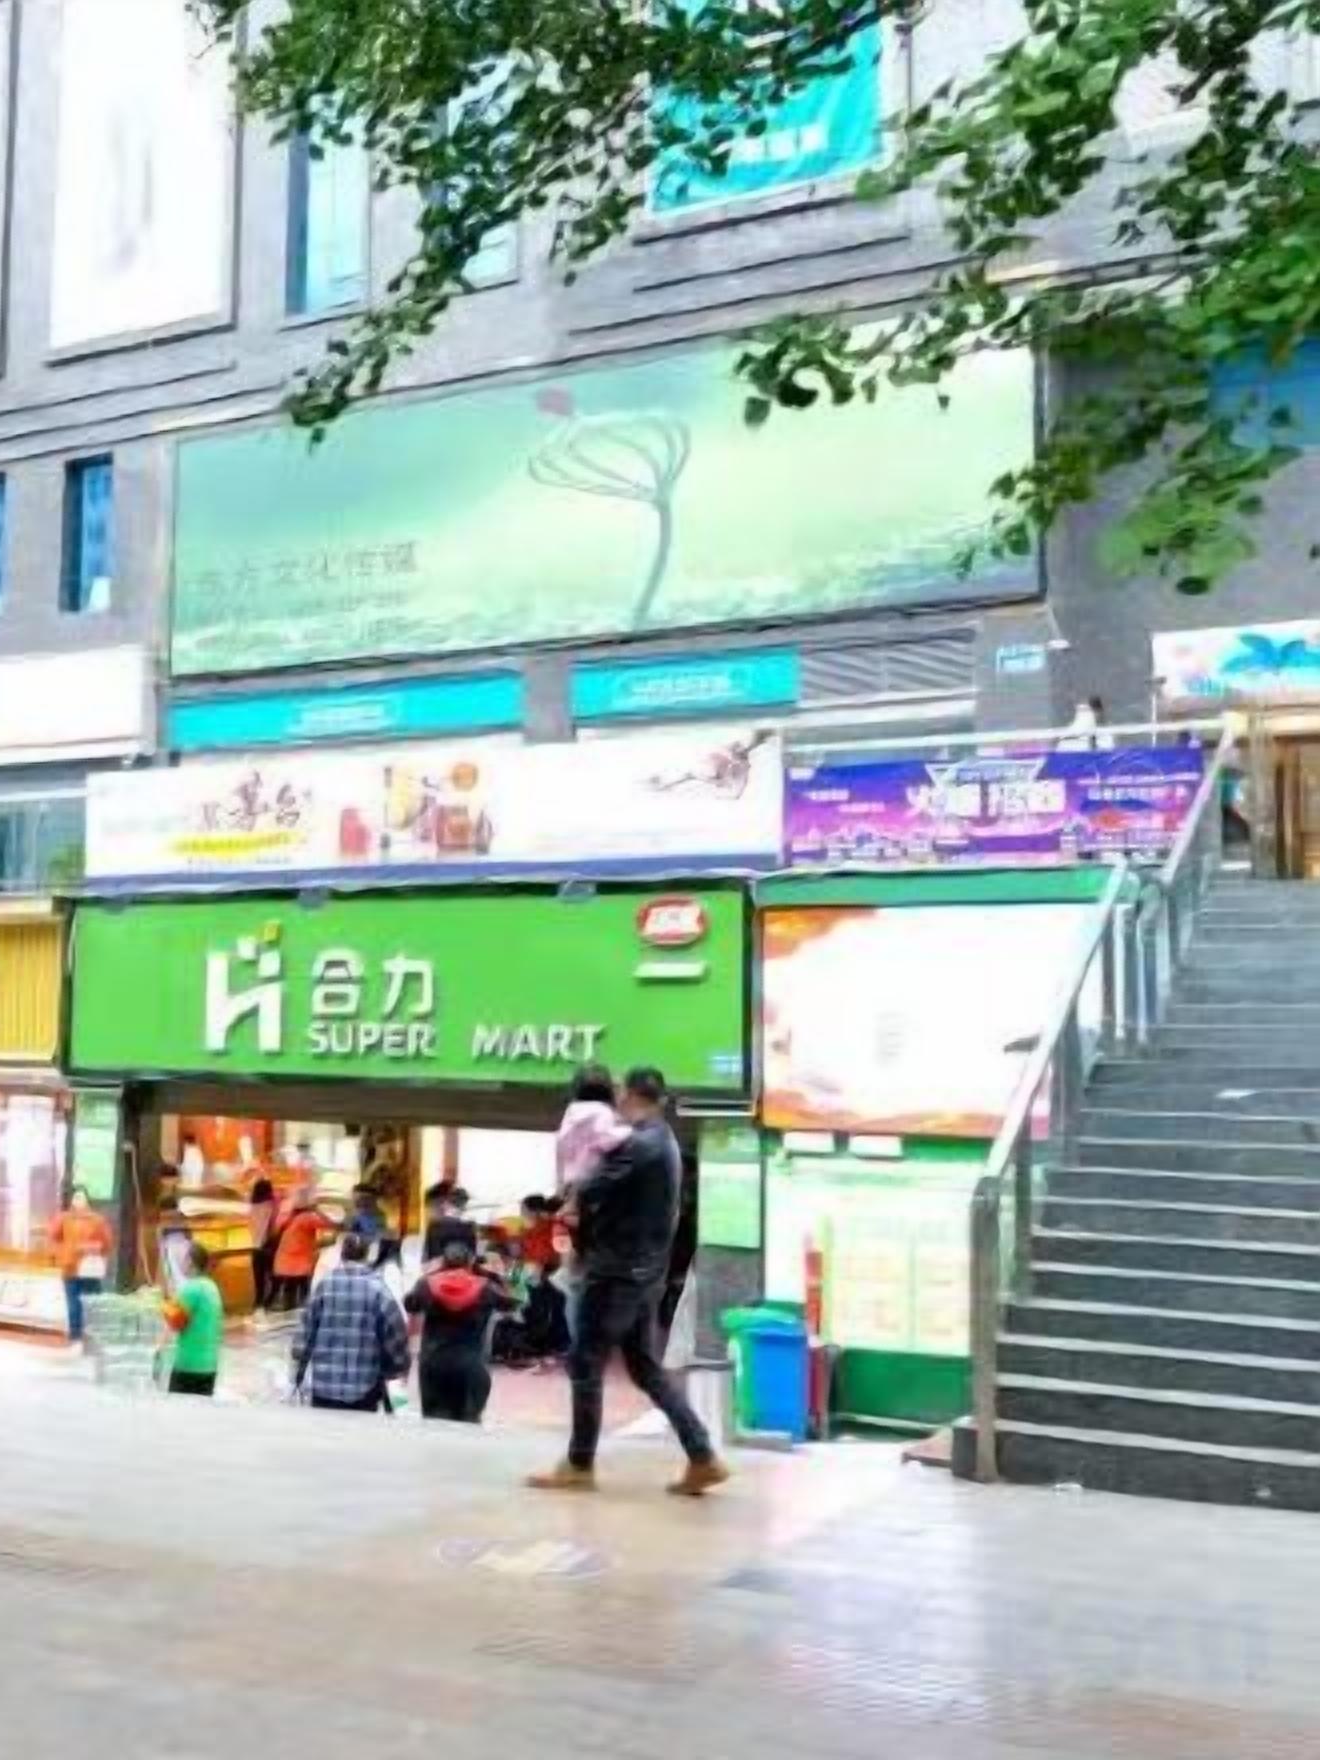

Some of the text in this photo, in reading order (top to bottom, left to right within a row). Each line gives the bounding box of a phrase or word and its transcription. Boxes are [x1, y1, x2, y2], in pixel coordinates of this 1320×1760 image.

[311, 948, 436, 1018] 合力
[307, 1022, 604, 1062] SUPER MART
